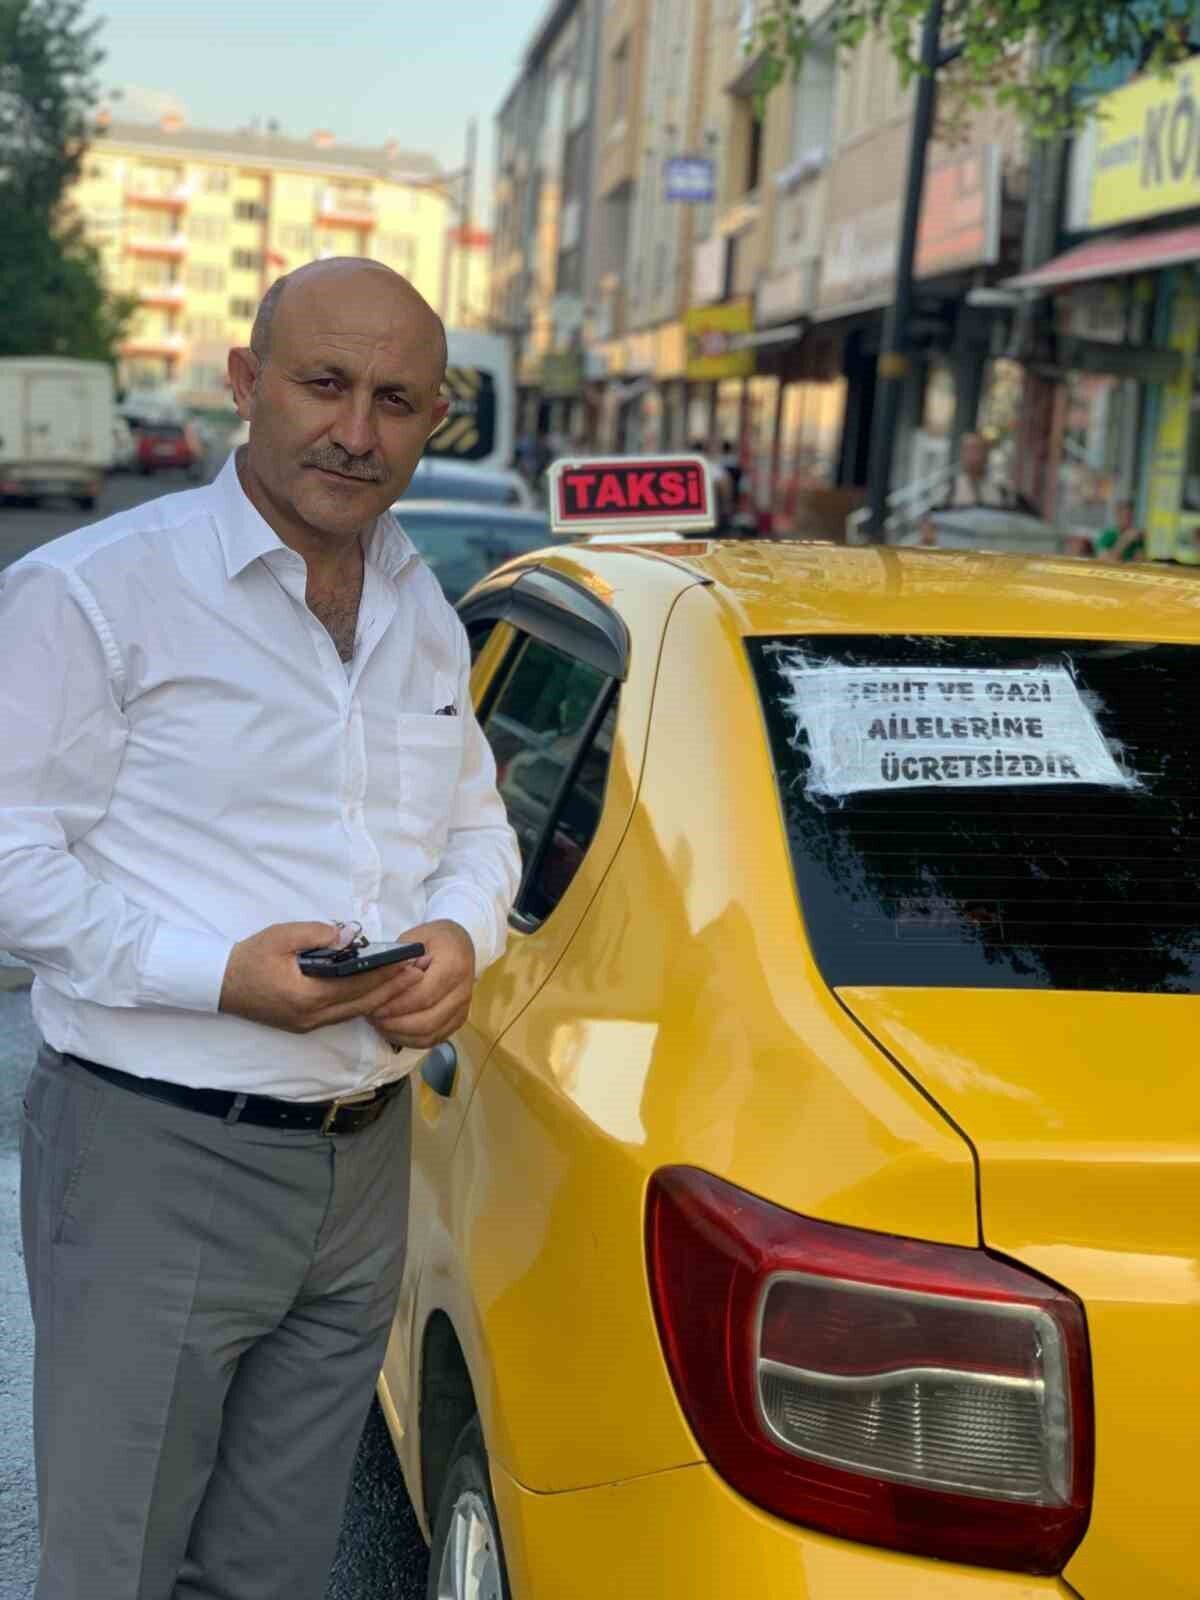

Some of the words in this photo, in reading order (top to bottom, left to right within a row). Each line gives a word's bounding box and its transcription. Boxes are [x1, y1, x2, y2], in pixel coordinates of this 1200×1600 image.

[1139, 73, 1200, 190] KÖ
[938, 682, 975, 702] VE
[867, 713, 1043, 740] AİLELERİNE
